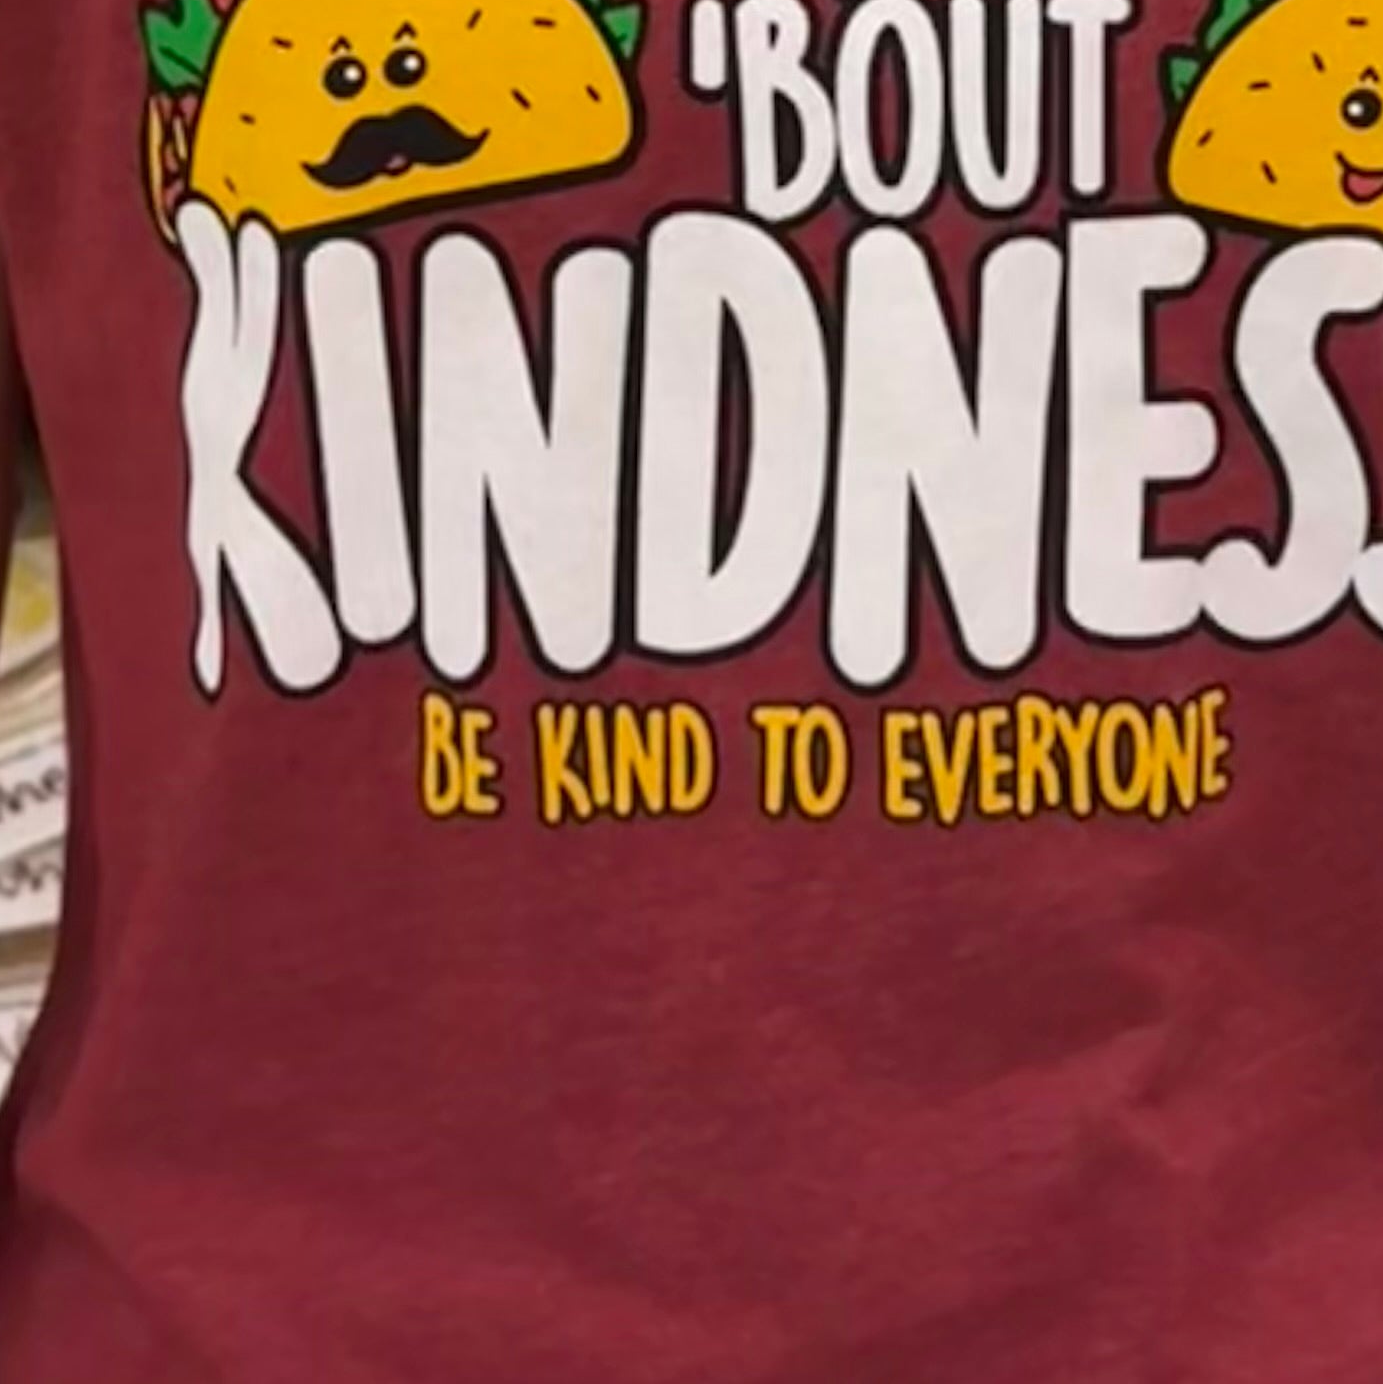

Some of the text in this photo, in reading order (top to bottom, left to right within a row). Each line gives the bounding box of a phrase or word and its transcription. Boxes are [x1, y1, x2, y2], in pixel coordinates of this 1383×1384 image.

[422, 688, 1229, 826] BE KIND TO EVERYONE
